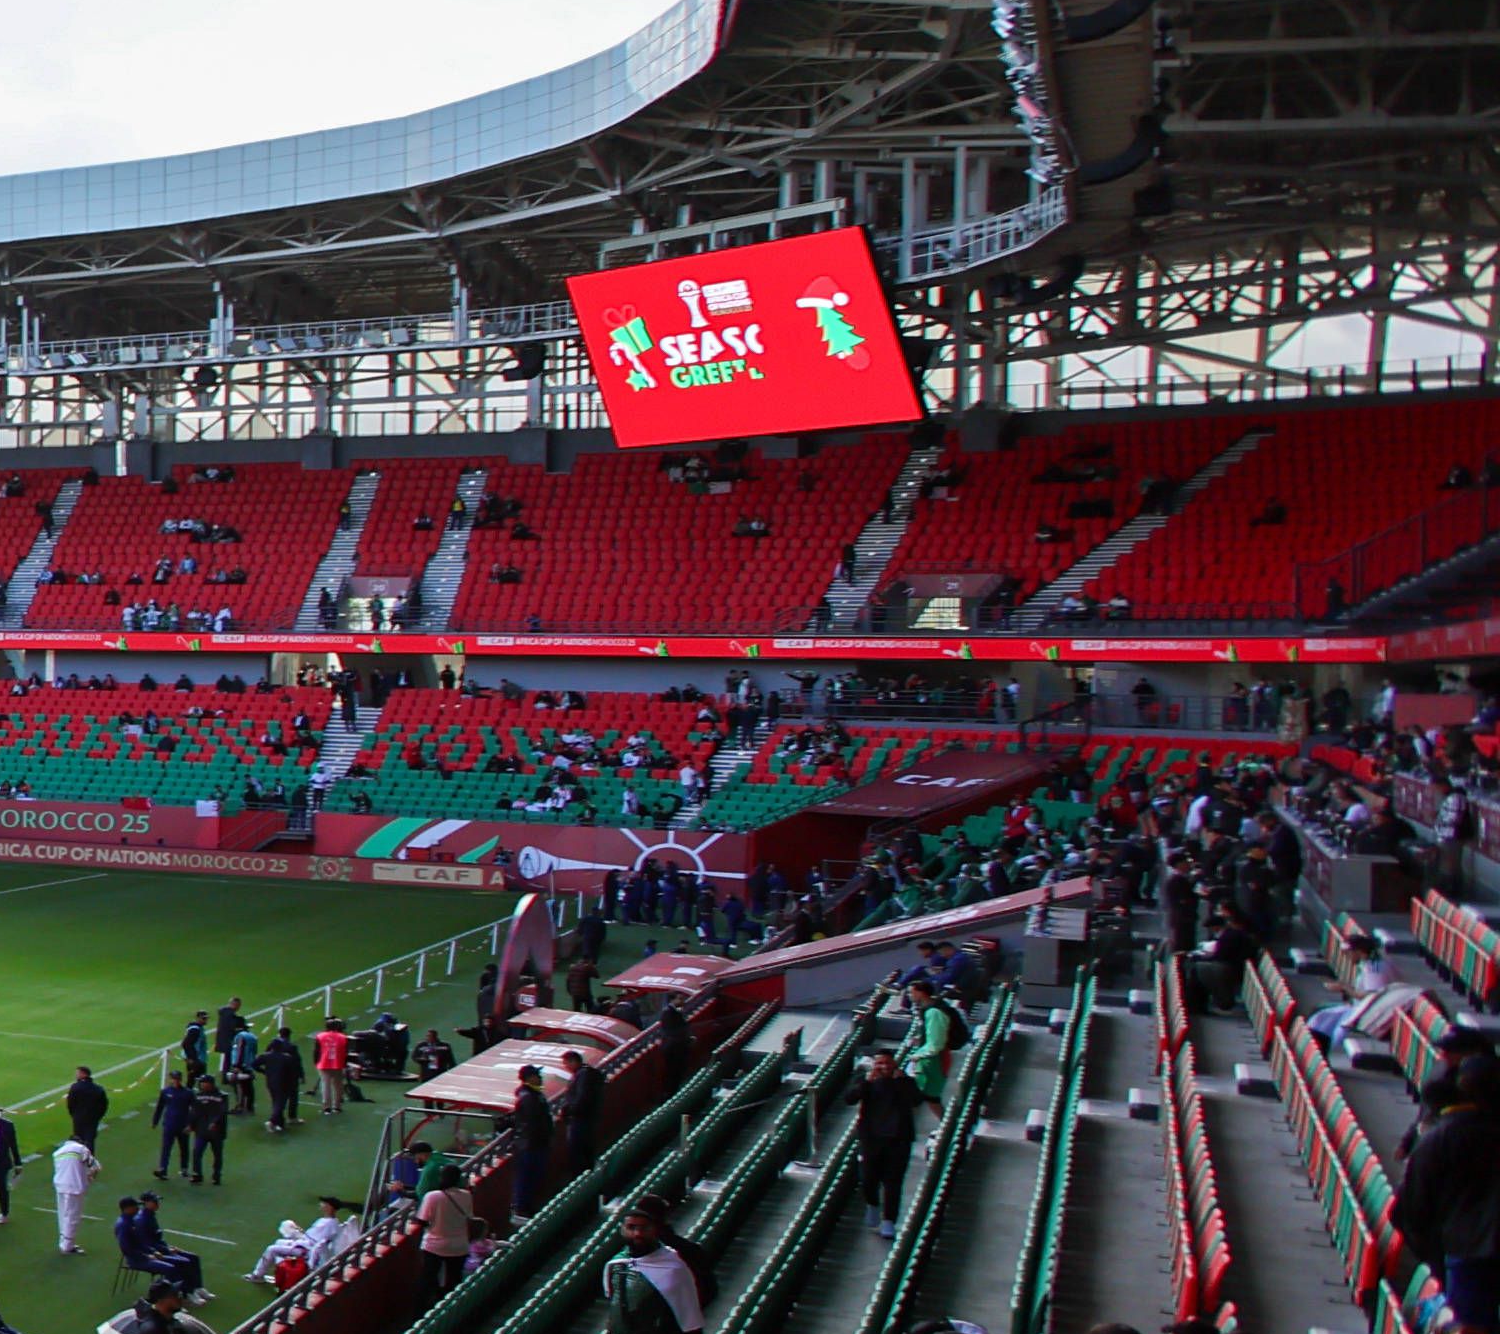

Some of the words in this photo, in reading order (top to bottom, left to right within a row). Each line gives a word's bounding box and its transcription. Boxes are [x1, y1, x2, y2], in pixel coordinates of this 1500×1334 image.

[893, 773, 998, 788] CAF
[121, 814, 150, 833] 25
[35, 843, 68, 860] CUP
[70, 845, 93, 861] OF
[96, 846, 170, 866] NATIONS
[171, 852, 265, 871] MOROCCO
[269, 858, 288, 873] 25
[414, 867, 470, 881] CAF
